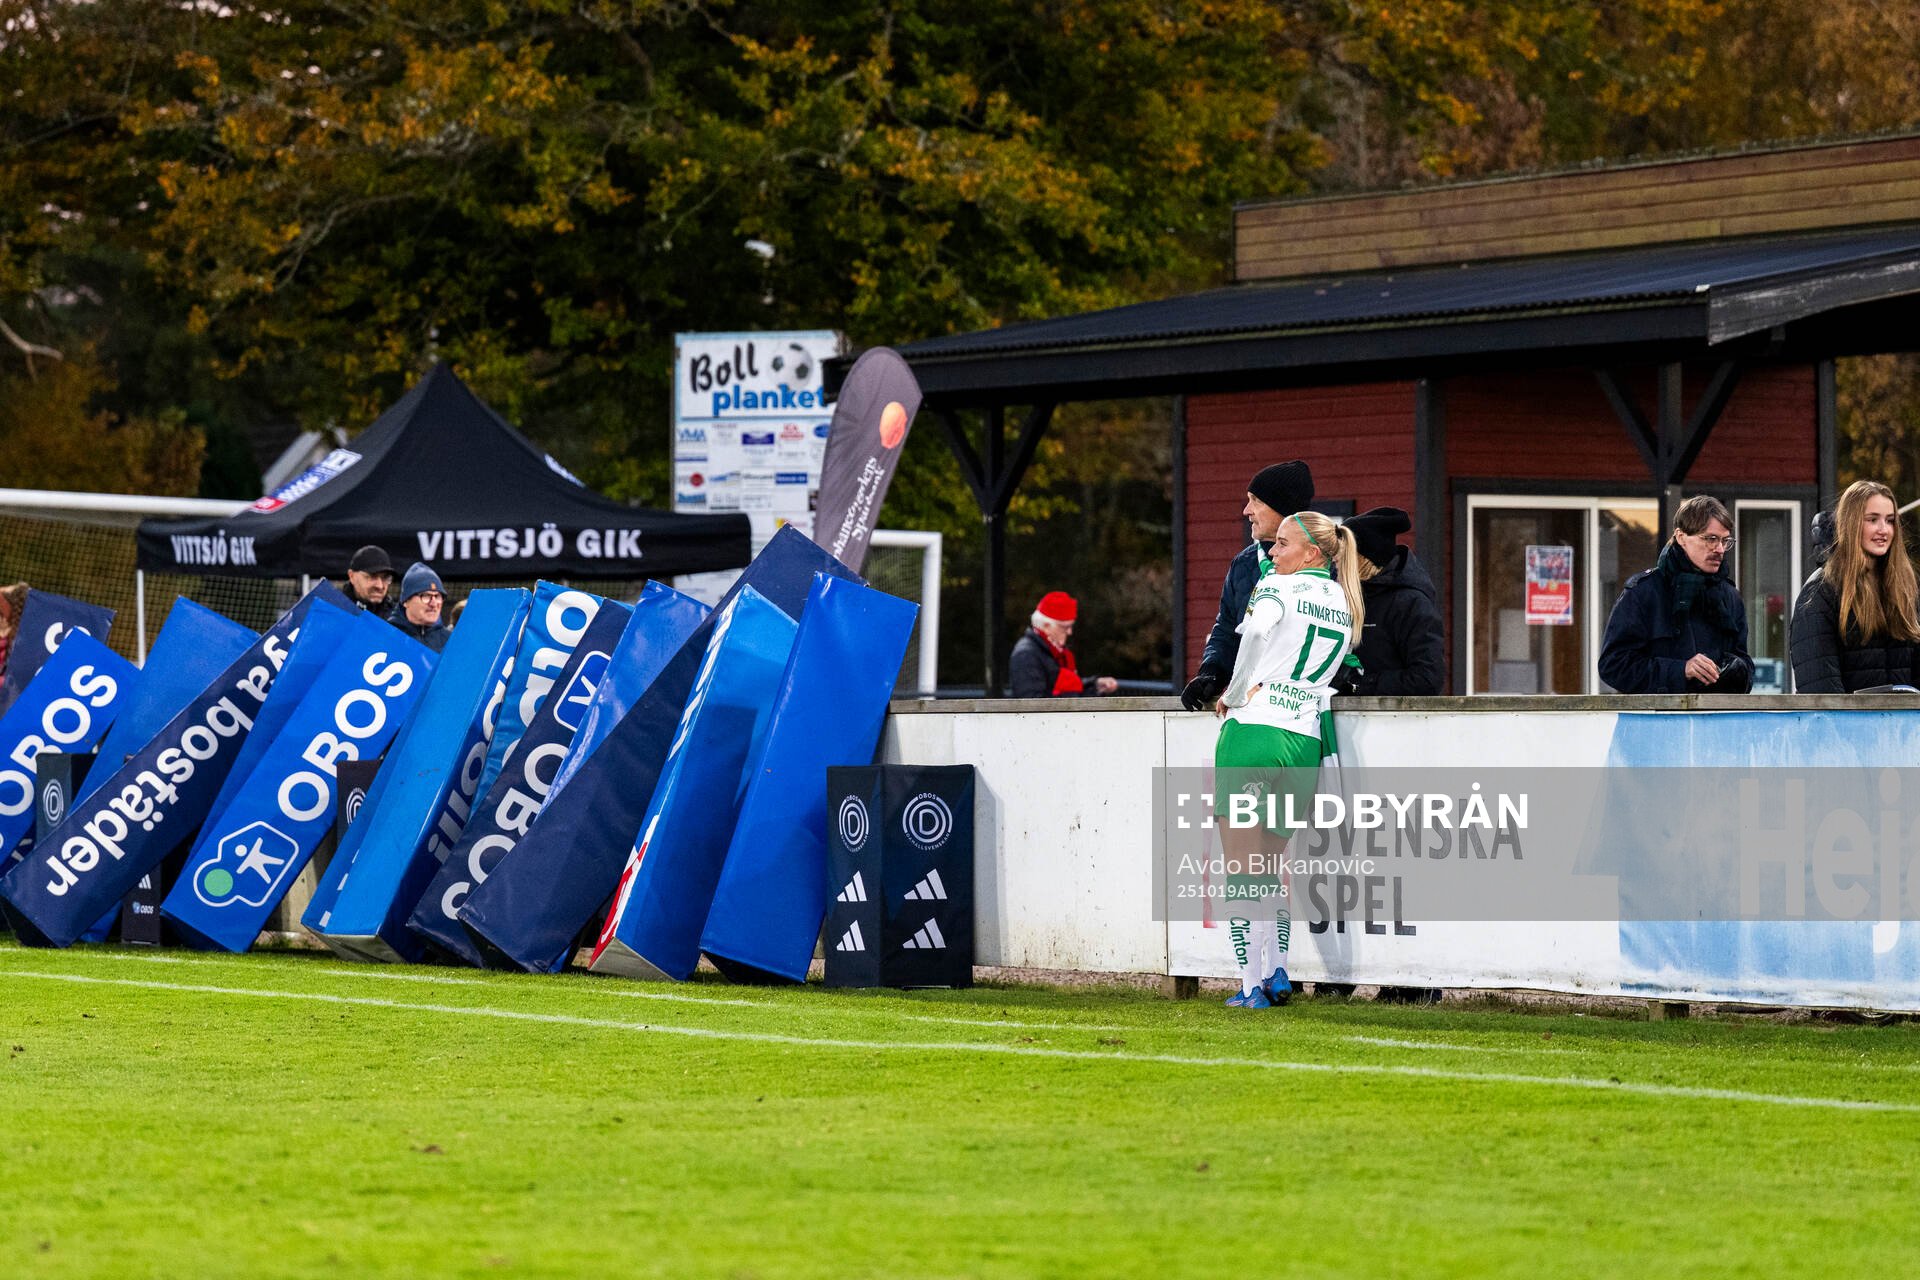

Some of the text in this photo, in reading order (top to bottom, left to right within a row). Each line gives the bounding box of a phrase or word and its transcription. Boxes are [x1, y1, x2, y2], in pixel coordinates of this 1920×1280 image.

[690, 342, 759, 392] Boll
[171, 529, 257, 566] VITTSJÖ GIK
[417, 522, 643, 561] VITTSJÖ GIK
[235, 627, 300, 703] ya
[1290, 623, 1345, 684] 17
[1269, 695, 1303, 712] BANK
[0, 664, 118, 817] OBOS
[277, 651, 414, 821] OBOS
[45, 696, 255, 896] bostäder
[918, 792, 937, 801] OBOS
[1308, 797, 1524, 860] SVENSKA
[1308, 873, 1417, 936] SPEL
